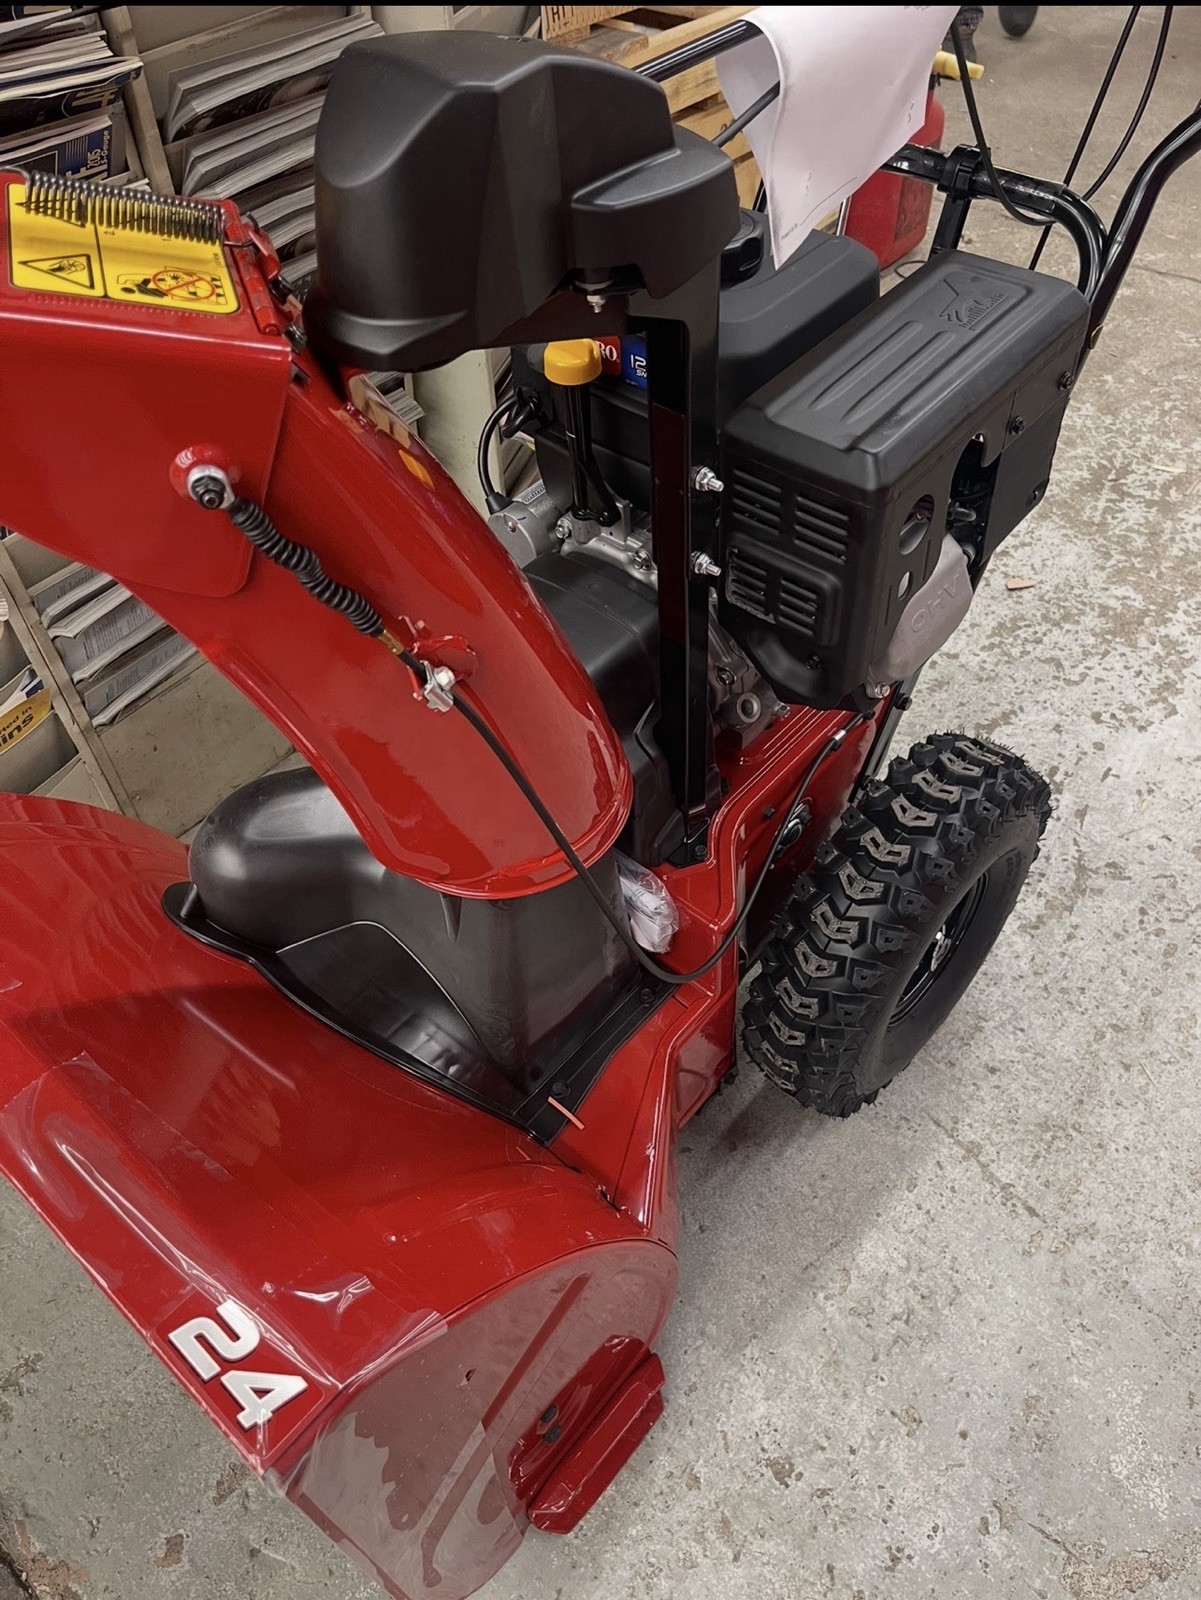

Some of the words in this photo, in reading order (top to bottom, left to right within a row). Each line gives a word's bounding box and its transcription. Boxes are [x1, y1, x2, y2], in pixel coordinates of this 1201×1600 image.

[100, 130, 110, 164] S-Gauge
[594, 340, 618, 362] RO
[0, 713, 34, 747] ins
[168, 1299, 308, 1430] 24
